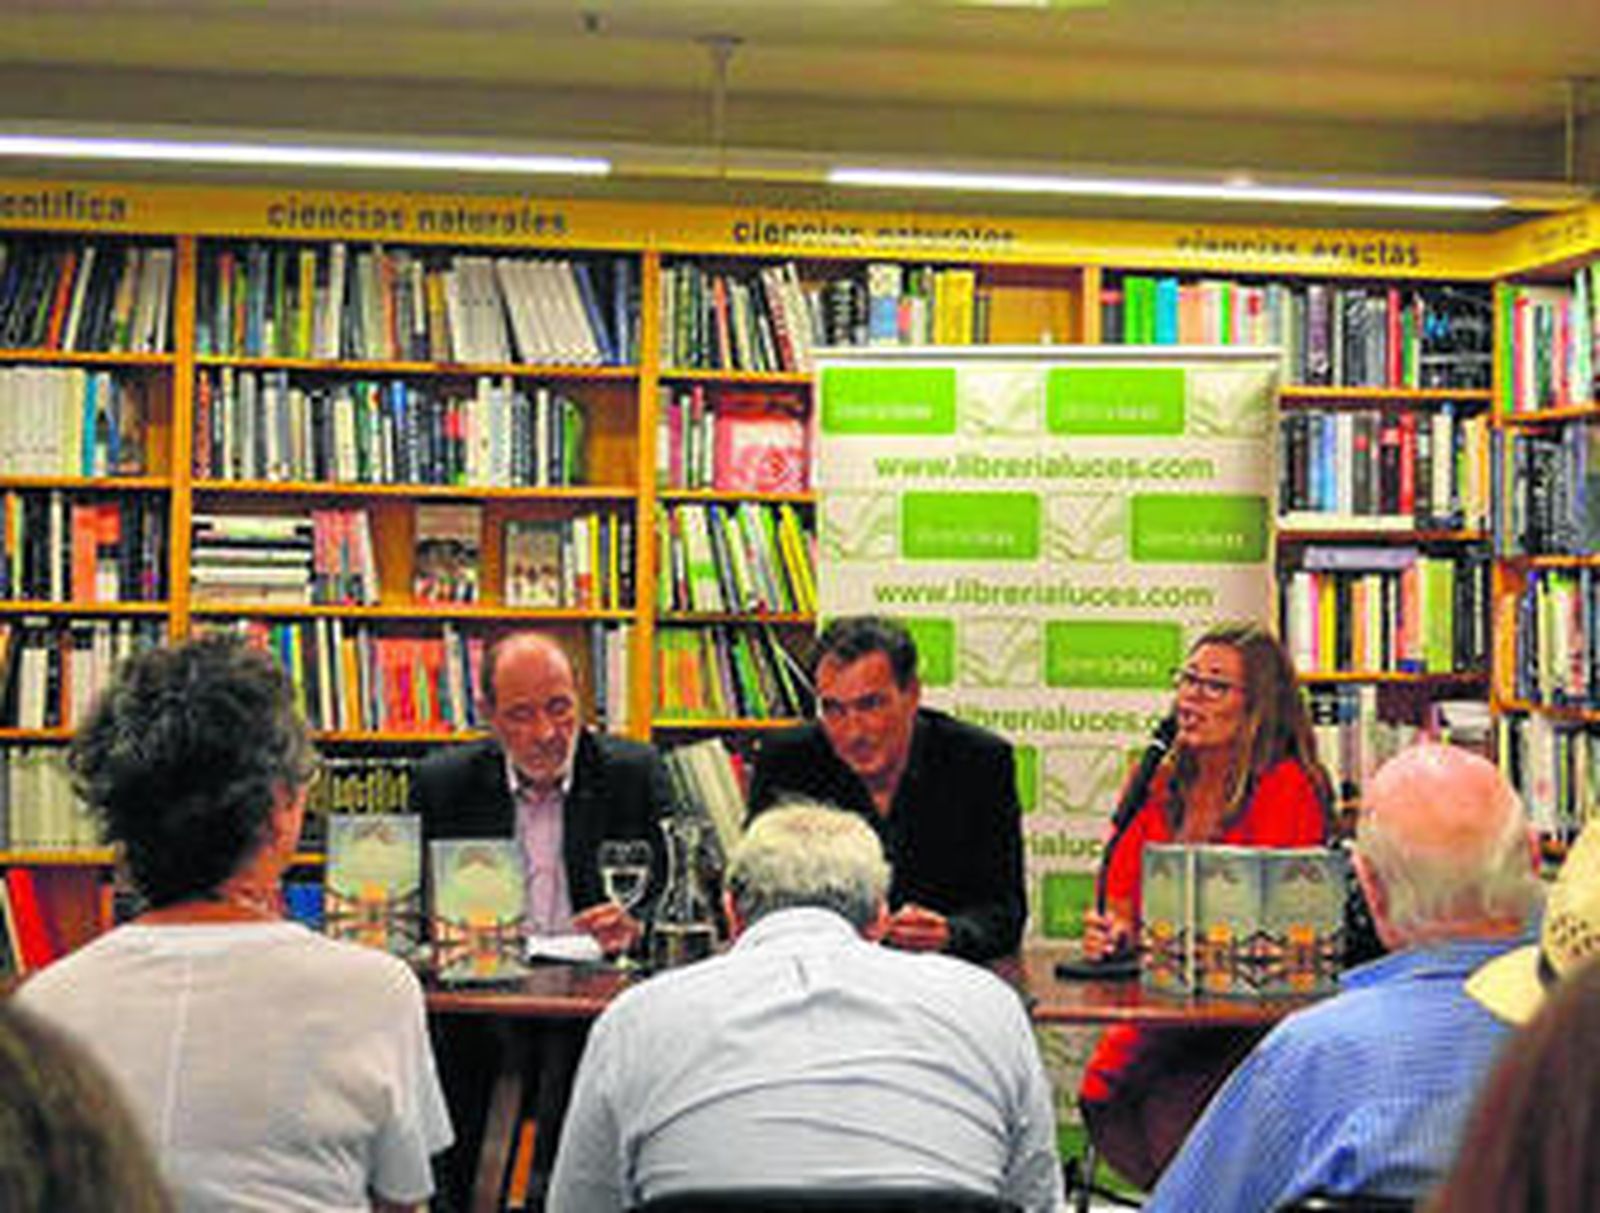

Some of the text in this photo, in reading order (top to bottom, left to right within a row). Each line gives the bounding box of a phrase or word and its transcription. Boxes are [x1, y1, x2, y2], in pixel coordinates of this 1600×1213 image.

[267, 202, 568, 234] ciencias naturales
[874, 454, 1215, 480] www.librerialuces.com
[874, 577, 1214, 608] www.librerialuces.com
